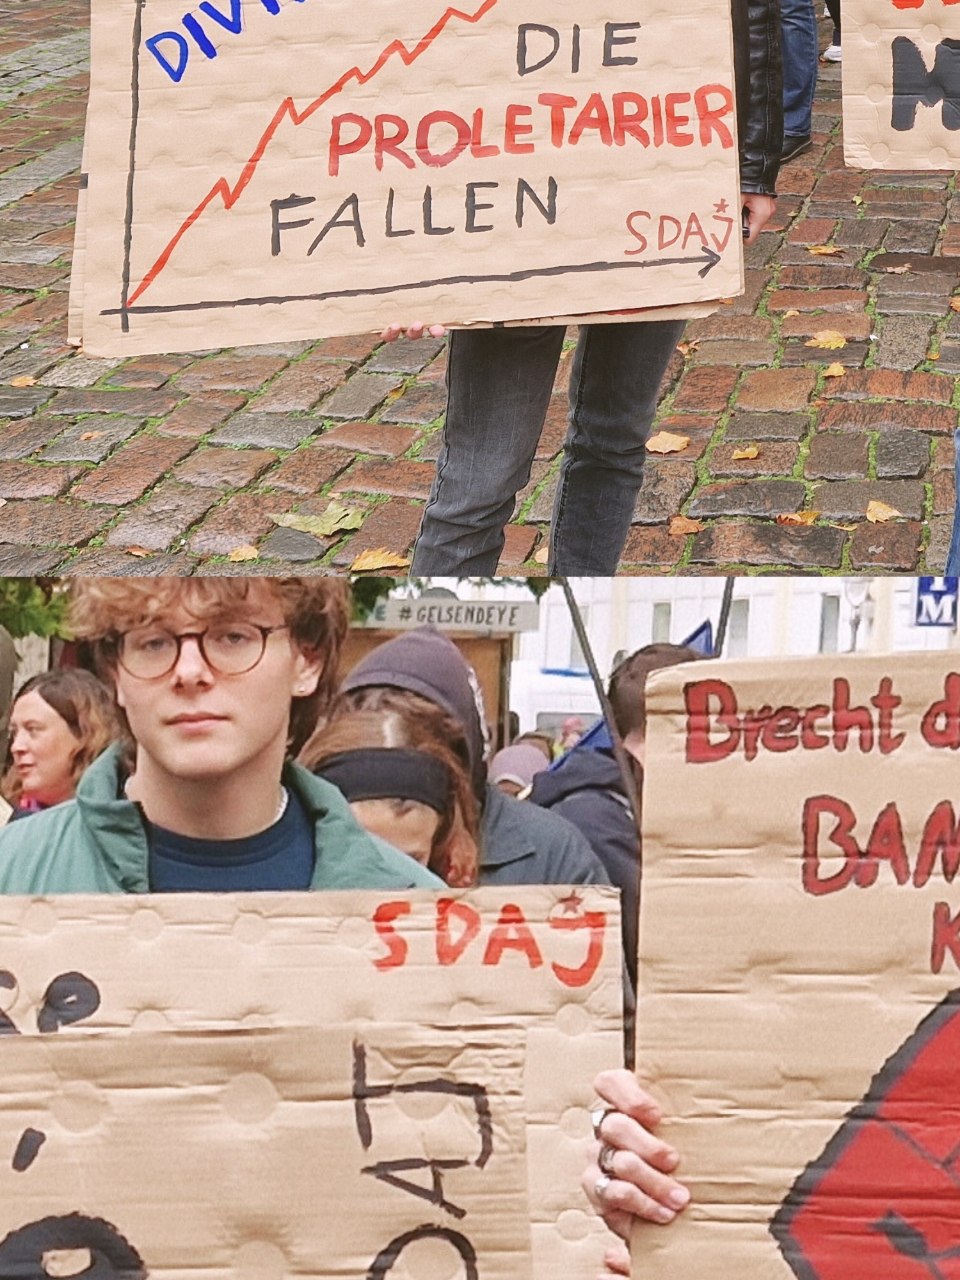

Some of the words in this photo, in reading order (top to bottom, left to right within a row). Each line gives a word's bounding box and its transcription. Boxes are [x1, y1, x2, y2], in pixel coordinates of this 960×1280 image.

[516, 22, 641, 76] DIE
[327, 83, 735, 177] PROLETARIER
[269, 176, 560, 257] FALLEN
[624, 199, 735, 256] SDAJ
[683, 676, 907, 766] Brecht
[371, 891, 608, 990] SDAJ
